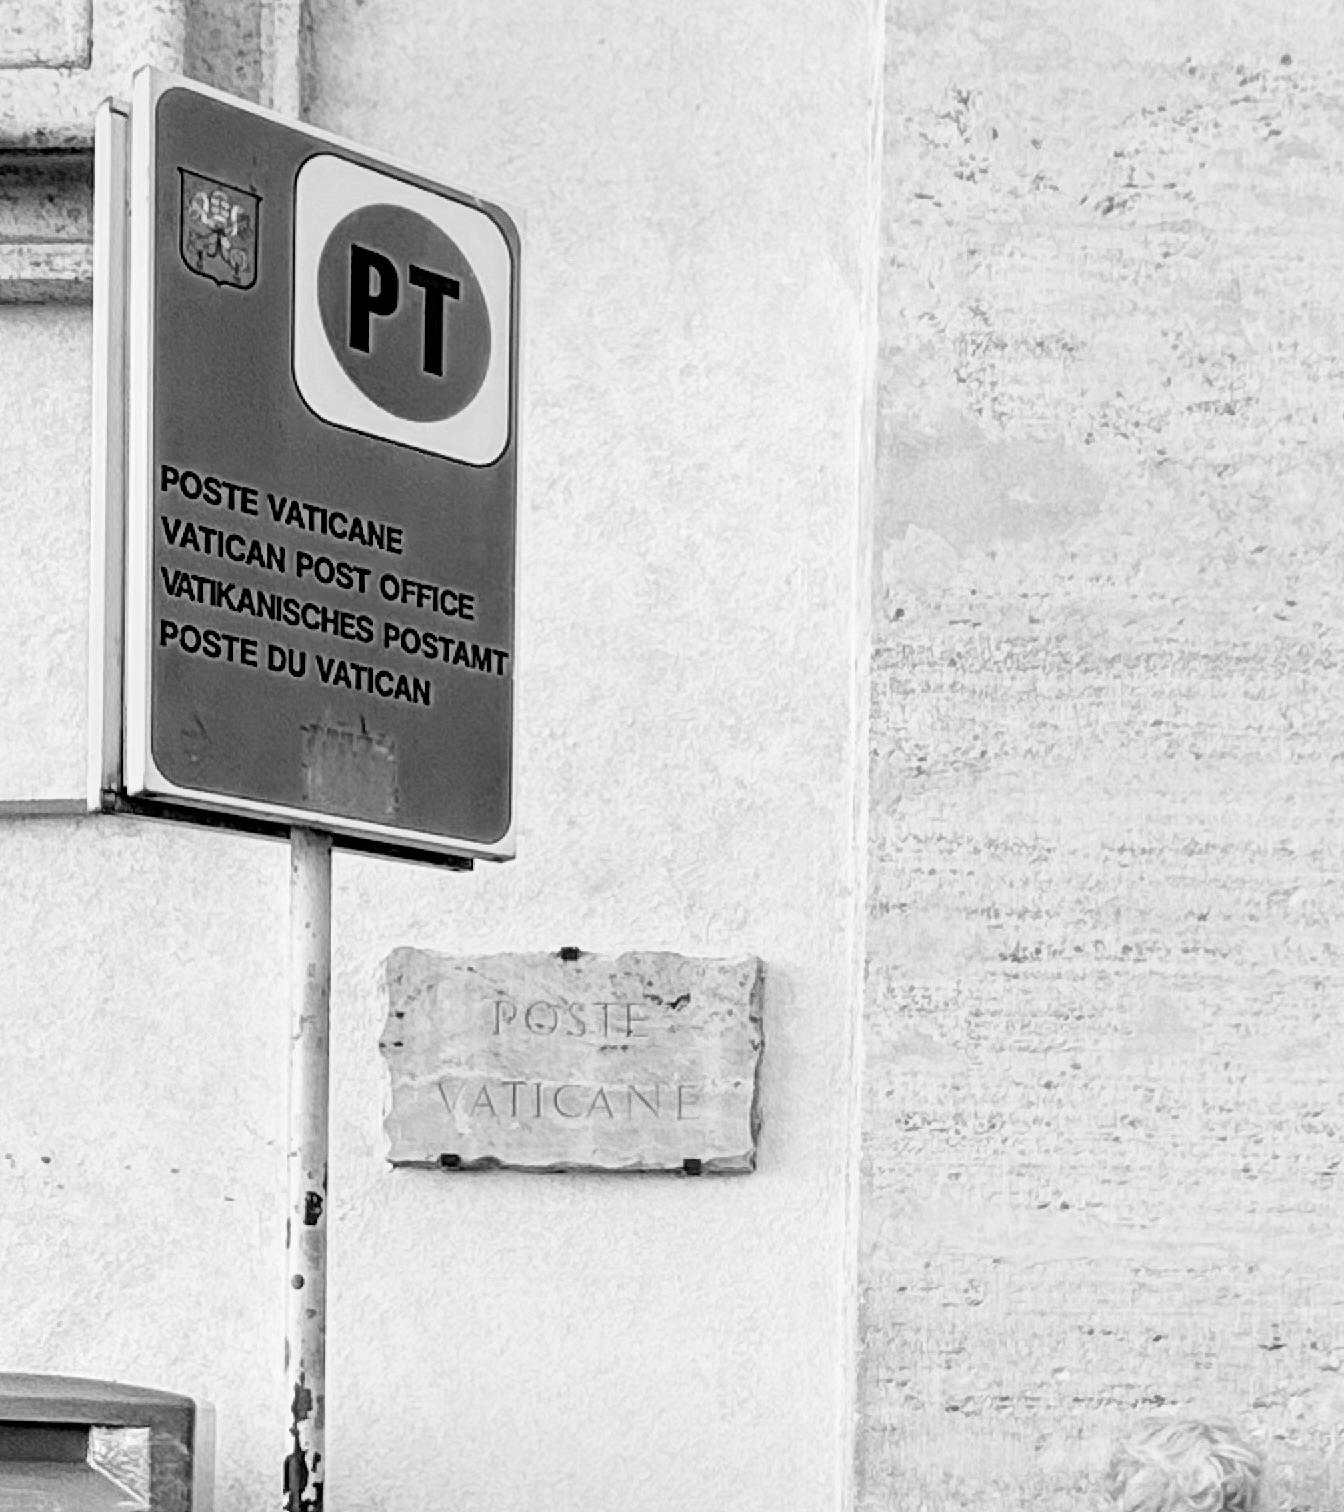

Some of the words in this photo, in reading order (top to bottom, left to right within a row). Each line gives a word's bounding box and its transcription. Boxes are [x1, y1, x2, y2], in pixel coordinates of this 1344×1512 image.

[349, 243, 460, 377] PT
[160, 464, 259, 516] POSTE
[267, 493, 404, 555] VATICANE
[160, 515, 286, 574] VATICAN
[295, 550, 372, 594] POST
[379, 573, 475, 621] OFFICE
[160, 566, 374, 643] VATIKANISCHES
[383, 622, 509, 676] POSTAMT
[160, 618, 258, 668] POSTE
[267, 643, 307, 678] DU
[315, 655, 431, 706] VATICAN
[492, 1000, 650, 1038] POSTE
[437, 1080, 701, 1120] VATICANE
